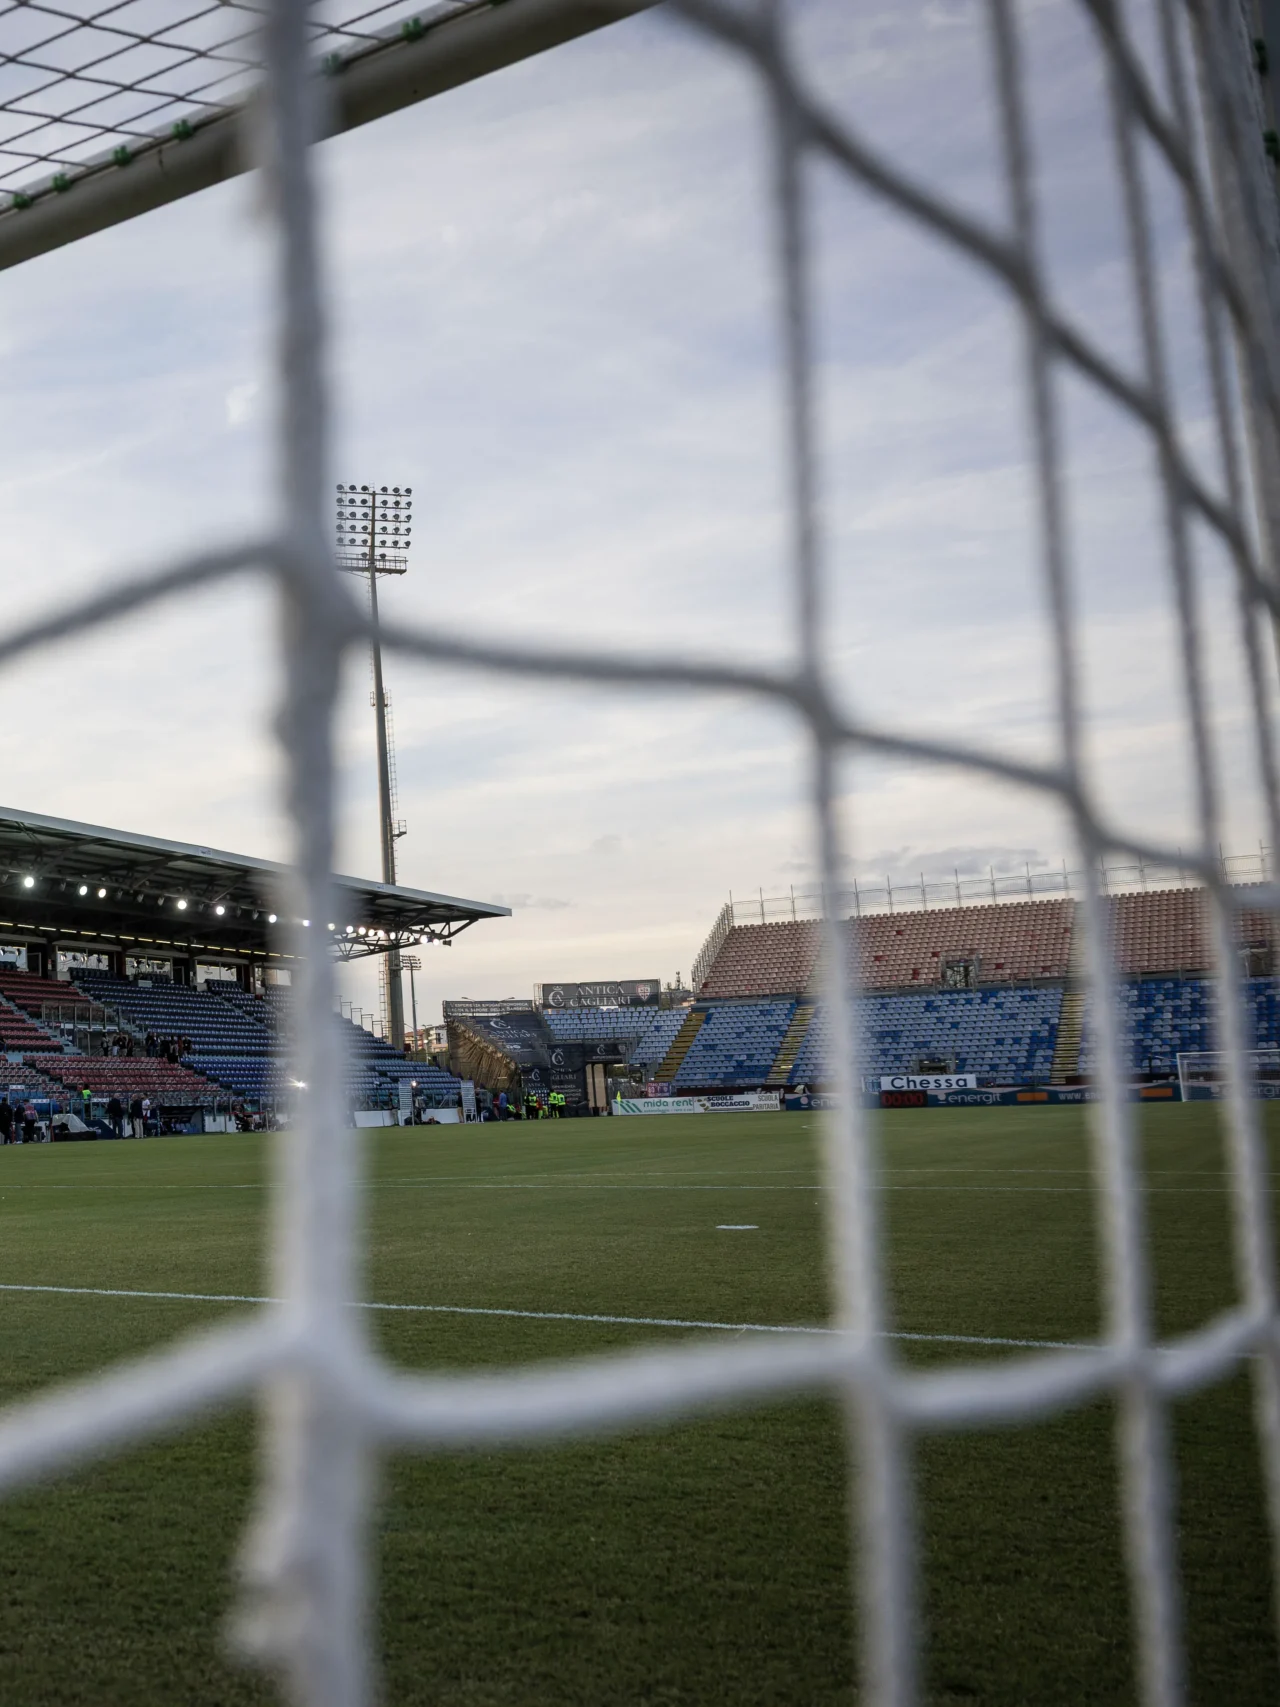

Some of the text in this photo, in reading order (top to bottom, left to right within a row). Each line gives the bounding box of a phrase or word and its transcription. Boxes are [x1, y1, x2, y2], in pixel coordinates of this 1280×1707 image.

[575, 985, 625, 995] ANTICA
[569, 996, 631, 1007] CAGLIARI
[890, 1075, 968, 1090] Chessa
[643, 1098, 693, 1108] mida rent
[710, 1100, 750, 1108] BOCCACCIO
[948, 1092, 1002, 1106] energit
